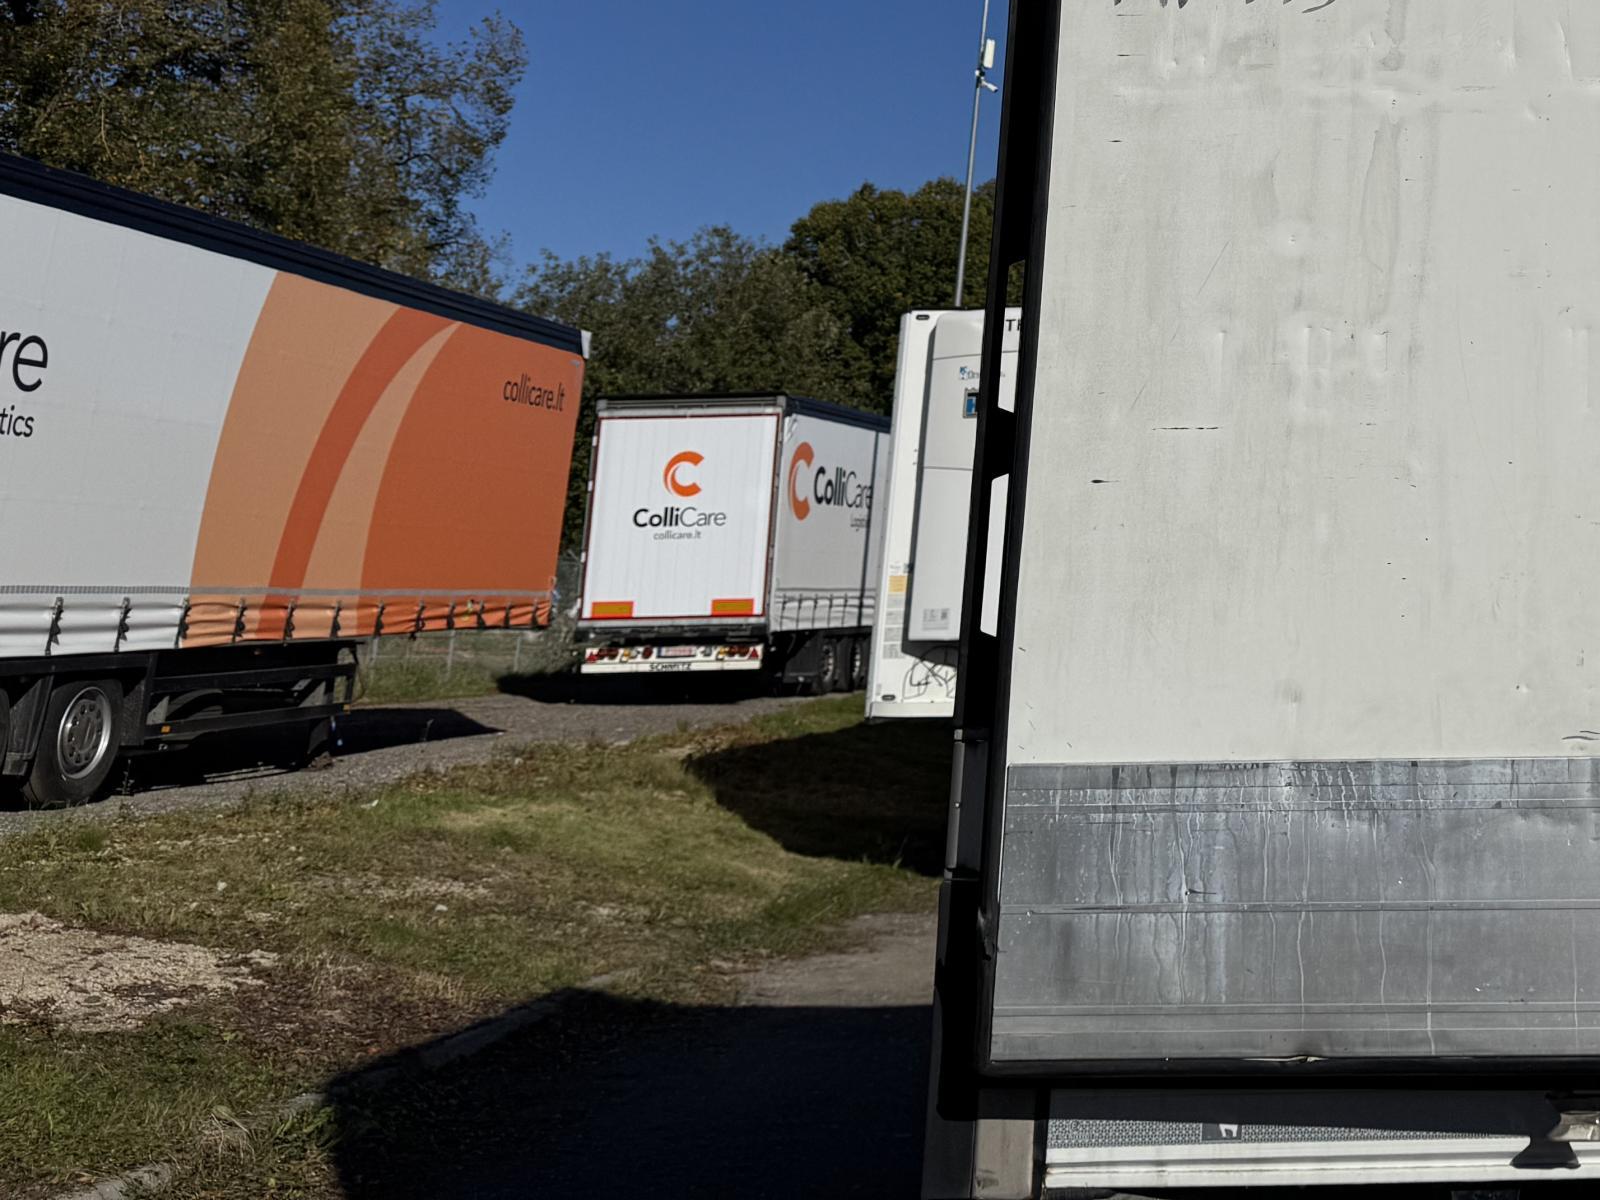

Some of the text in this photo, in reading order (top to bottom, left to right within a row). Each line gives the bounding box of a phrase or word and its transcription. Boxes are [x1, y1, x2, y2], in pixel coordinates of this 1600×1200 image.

[0, 331, 48, 392] re
[503, 372, 565, 412] collicare.lt
[813, 465, 873, 509] ColliCare
[632, 506, 727, 528] ColliCare
